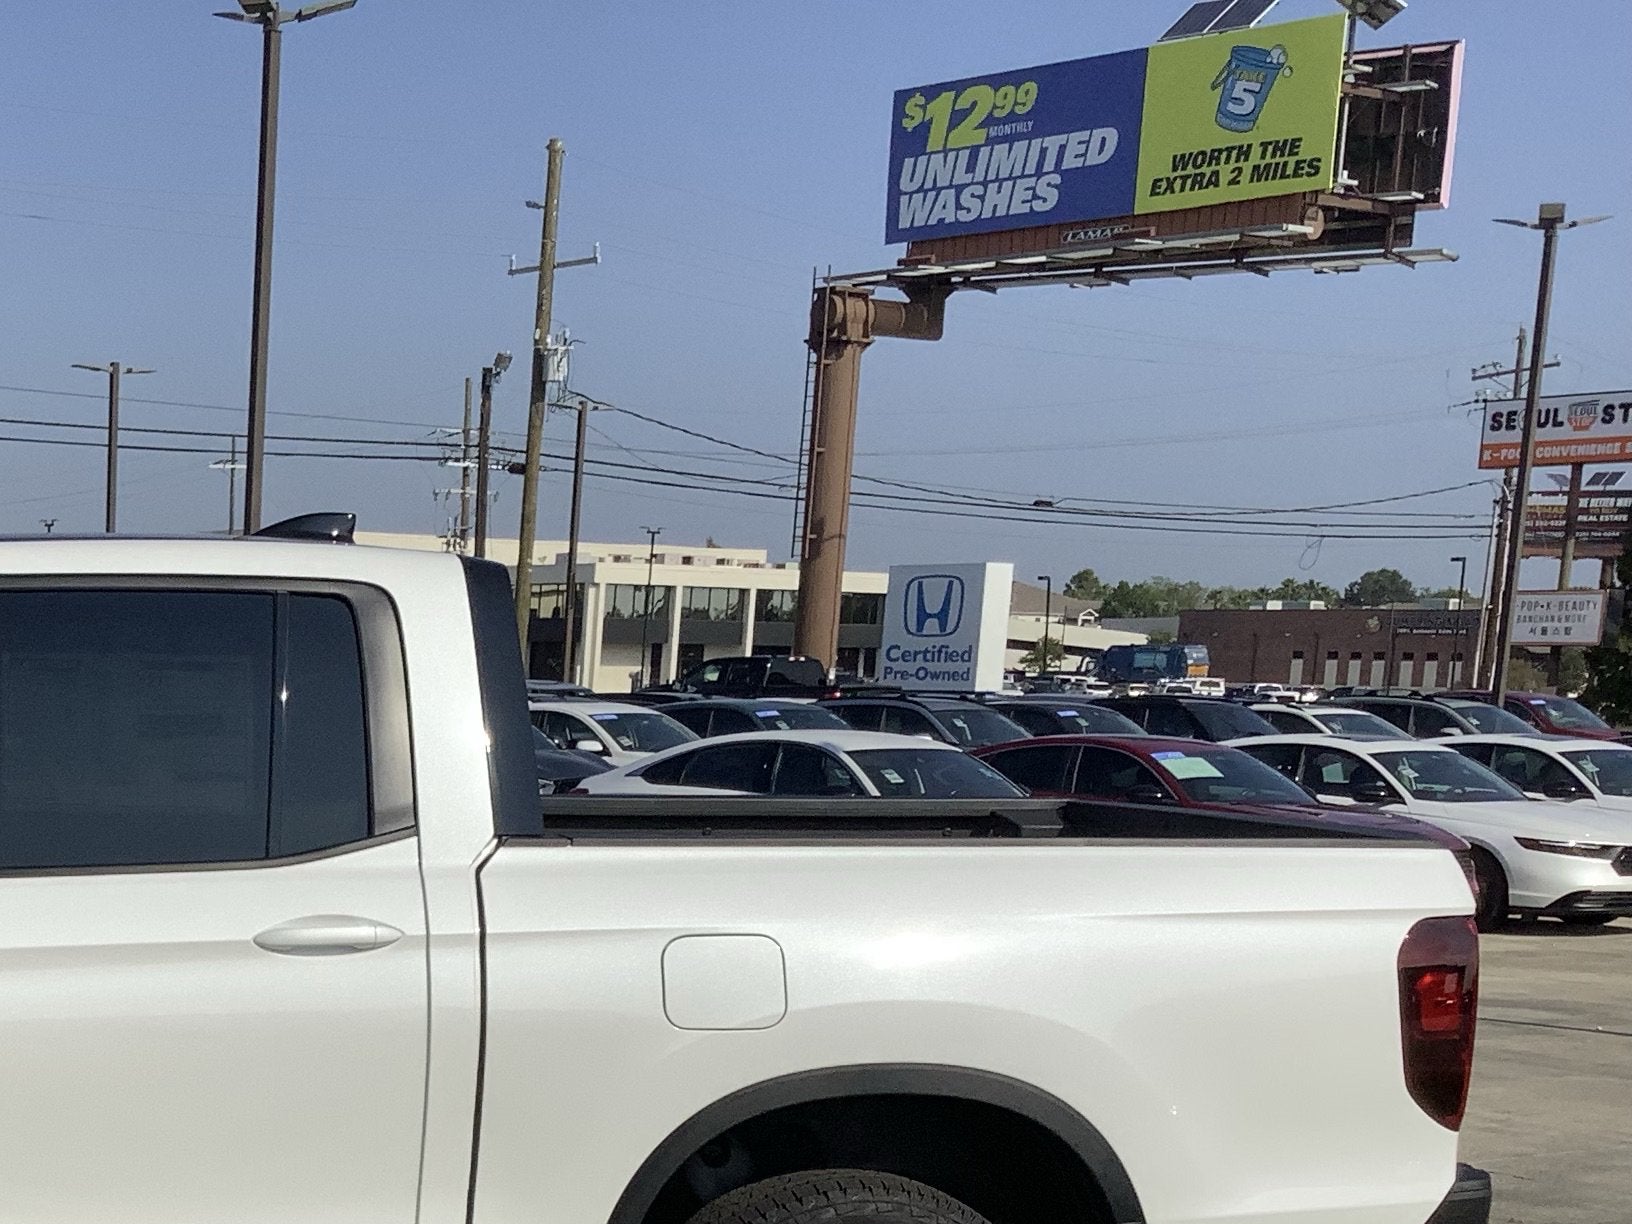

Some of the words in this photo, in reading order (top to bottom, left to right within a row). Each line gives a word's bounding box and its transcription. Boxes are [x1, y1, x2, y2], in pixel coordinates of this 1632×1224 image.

[1226, 79, 1263, 116] 5
[988, 119, 1034, 138] MONTHLY
[899, 127, 1118, 192] UNLIMITED
[1171, 143, 1253, 173] WORTH
[1259, 137, 1303, 161] THE
[1149, 166, 1220, 197] EXTRA
[1227, 166, 1244, 186] 2
[1249, 157, 1322, 184] MILES
[898, 173, 1062, 229] WASHES
[1535, 442, 1622, 458] CONVENIENCE
[885, 643, 973, 663] Certified
[883, 665, 971, 682] Pre-Owned
